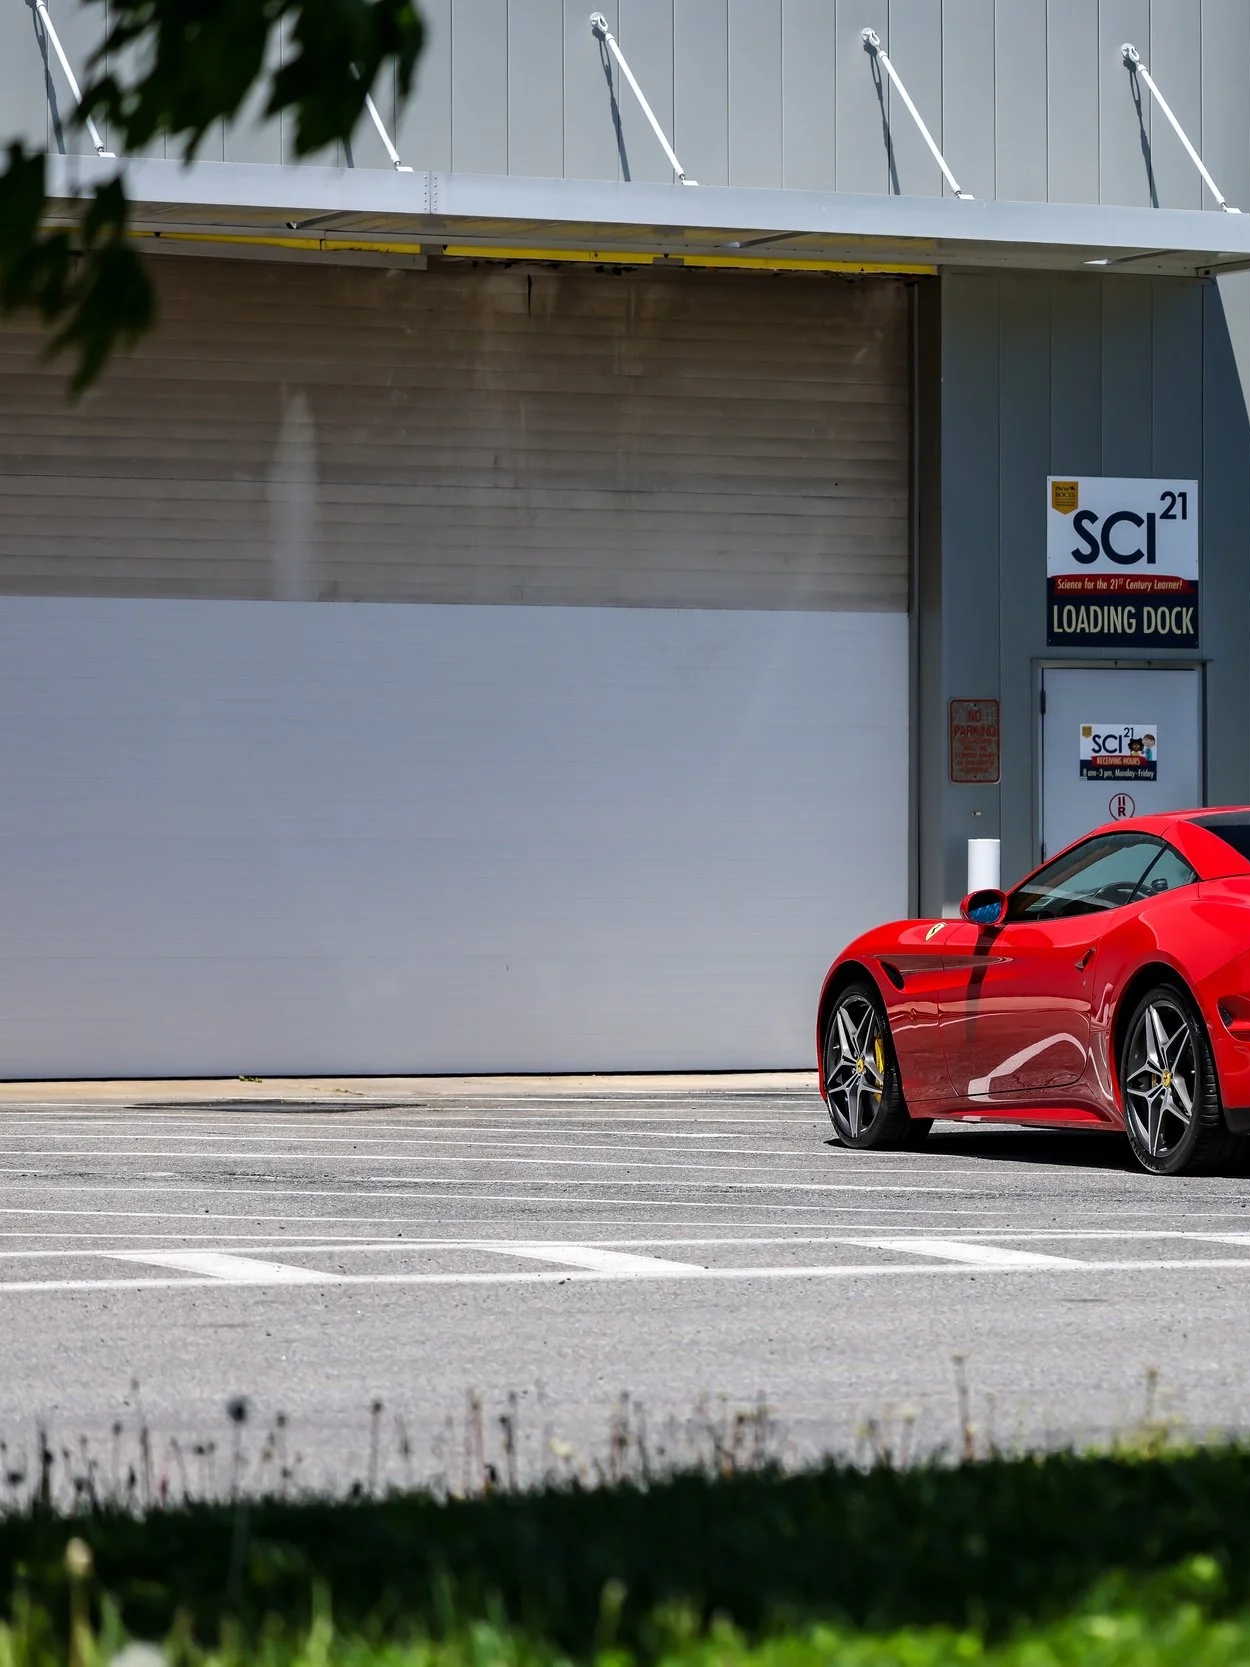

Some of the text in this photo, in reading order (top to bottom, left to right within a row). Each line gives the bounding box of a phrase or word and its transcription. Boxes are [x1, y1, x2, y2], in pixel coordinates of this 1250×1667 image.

[1057, 578, 1082, 590] Science
[1084, 578, 1095, 590] for
[1097, 578, 1108, 590] the
[1125, 579, 1153, 592] Century
[1154, 579, 1183, 591] Learner!
[1053, 604, 1194, 635] LOADING DOCK
[968, 709, 982, 721] NO
[955, 724, 997, 737] PARKING
[1096, 757, 1141, 766] RECEIVING HOURS
